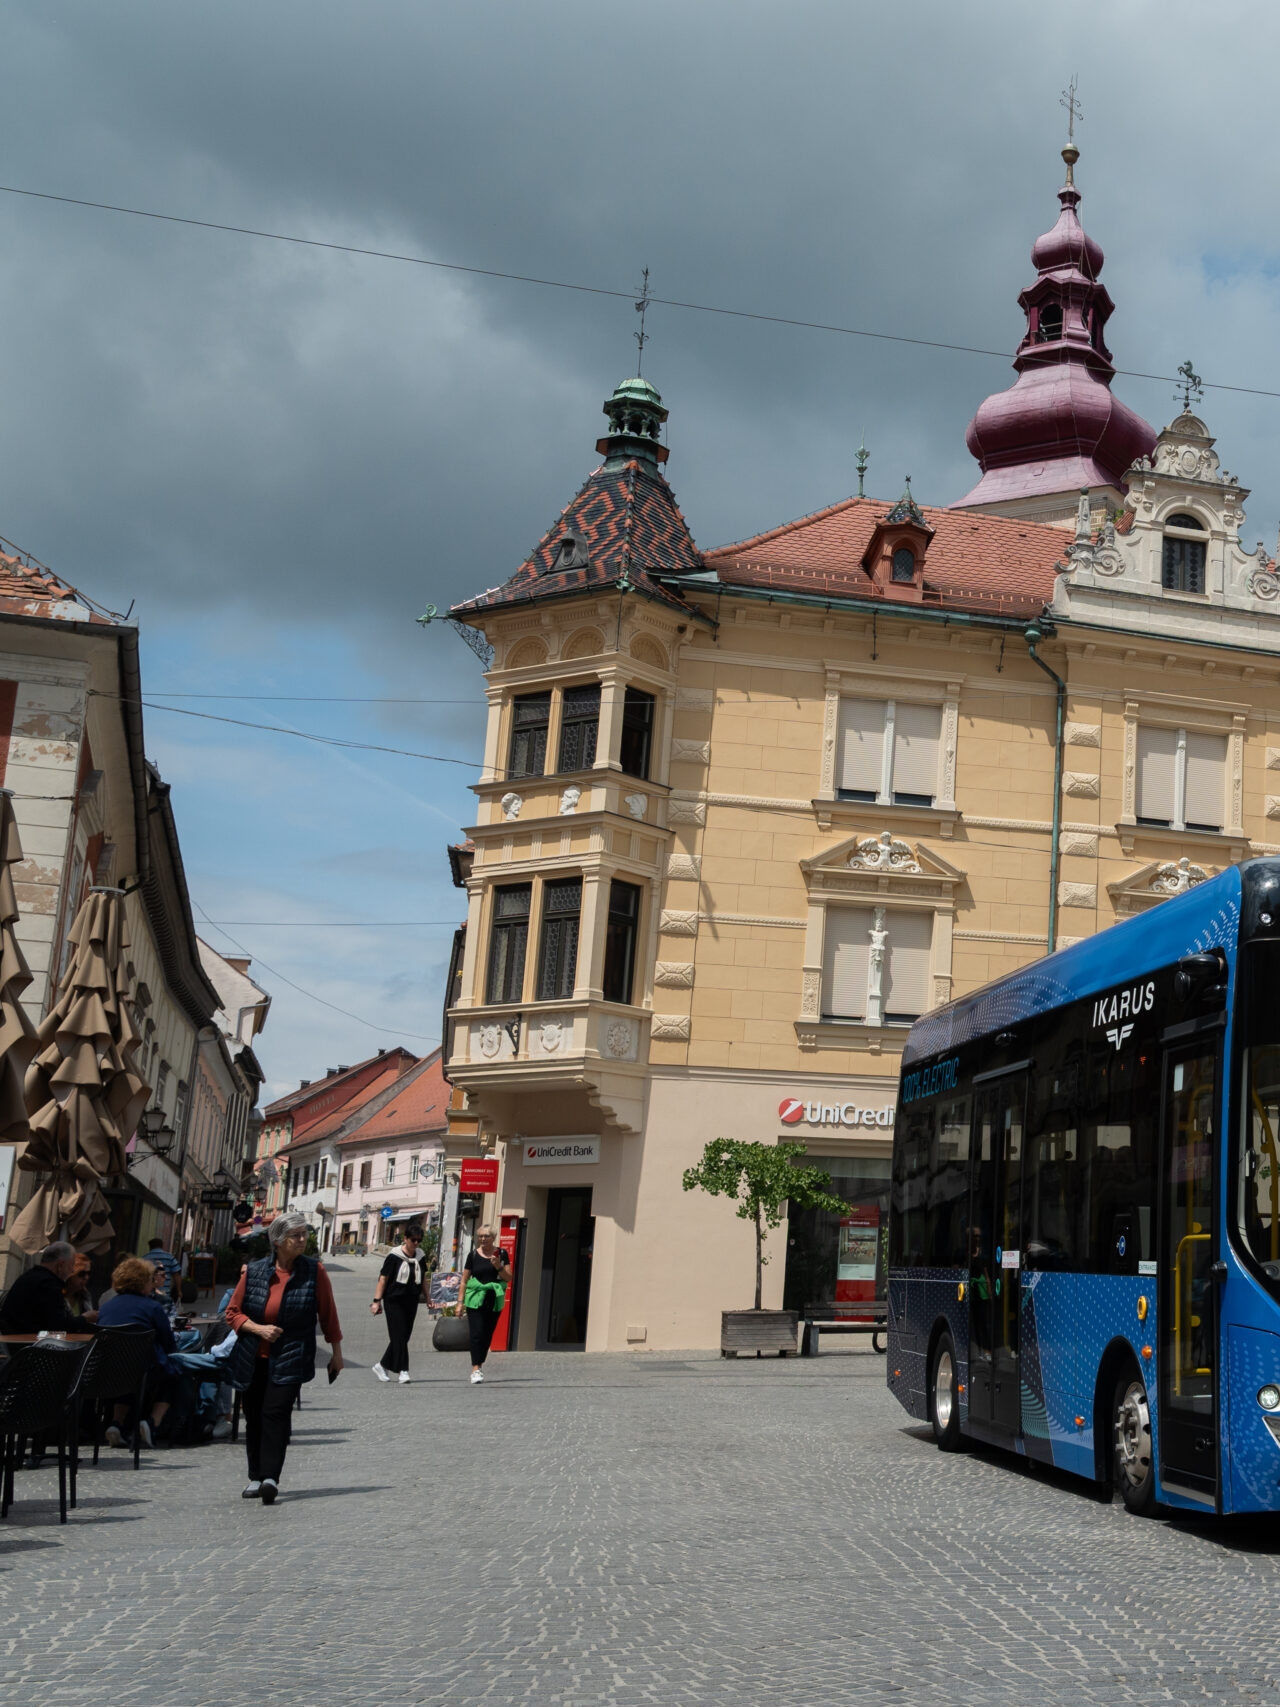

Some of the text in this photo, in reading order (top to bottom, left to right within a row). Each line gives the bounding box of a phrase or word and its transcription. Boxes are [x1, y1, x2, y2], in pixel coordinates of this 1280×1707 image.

[1092, 981, 1155, 1028] IKARUS
[903, 1056, 960, 1104] 100% ELECTRIC
[806, 1101, 895, 1126] UniCredi
[537, 1145, 594, 1158] UniCredit Bank
